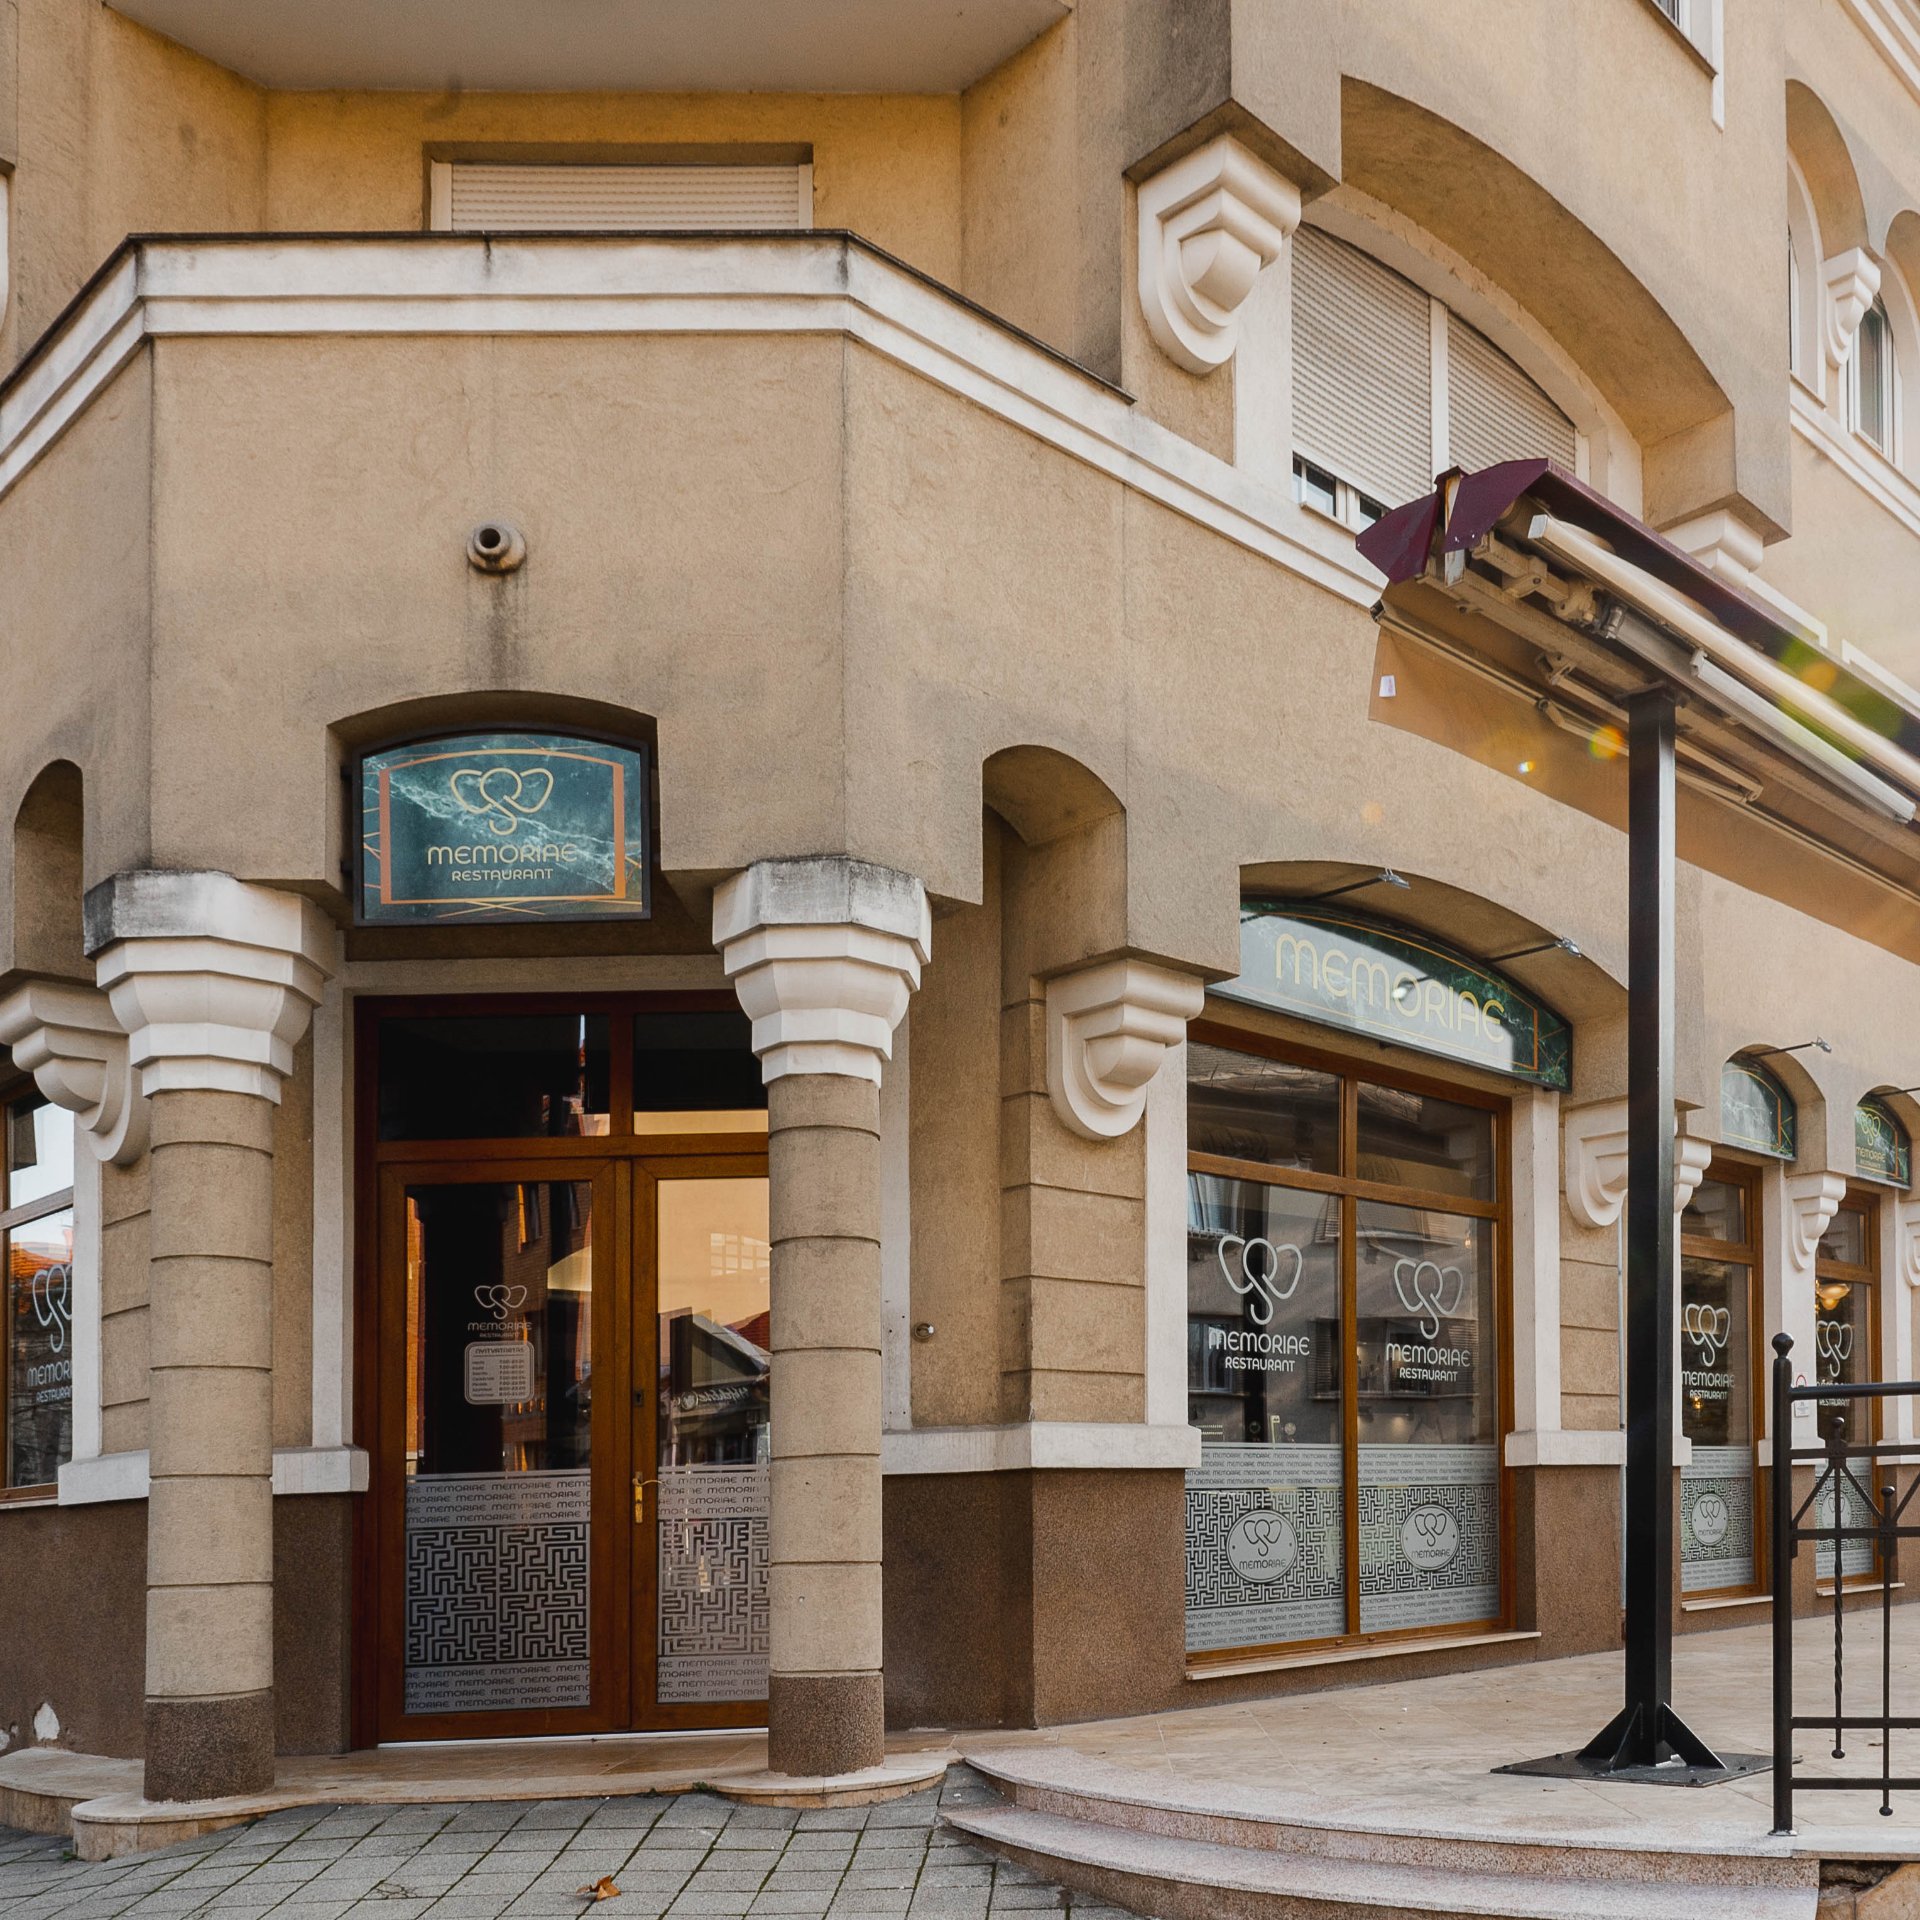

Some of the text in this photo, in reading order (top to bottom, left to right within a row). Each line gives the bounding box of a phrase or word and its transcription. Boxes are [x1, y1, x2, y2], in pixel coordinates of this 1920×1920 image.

[427, 843, 578, 865] MEMORIAE
[452, 868, 554, 882] RESTAURANT
[1275, 933, 1505, 1043] MEMORIAE
[1208, 1330, 1310, 1356] MEMORIAE
[1386, 1342, 1471, 1367] MEMORIAE
[1225, 1356, 1296, 1373] RESTAURANT
[1399, 1367, 1458, 1382] RESTAURANT
[1681, 1370, 1736, 1389] MEMORIAE
[426, 1484, 486, 1494] MEMORIAE
[492, 1481, 551, 1491] MEMORIAE
[456, 1492, 515, 1502] MEMORIAE
[426, 1504, 486, 1513] MEMORIAE
[455, 1512, 515, 1522] MEMORIAE
[1411, 1548, 1451, 1559] MEMORIAE
[1239, 1558, 1287, 1570] MEMORIAE
[425, 1669, 485, 1678] MEMORIAE
[491, 1666, 551, 1675] MEMORIAE
[455, 1677, 514, 1687] MEMORIAE
[520, 1675, 580, 1684] MEMORIAE
[425, 1689, 485, 1698] MEMORIAE
[491, 1687, 551, 1696] MEMORIAE
[455, 1698, 515, 1707] MEMORIAE
[520, 1695, 580, 1704] MEMORIAE
